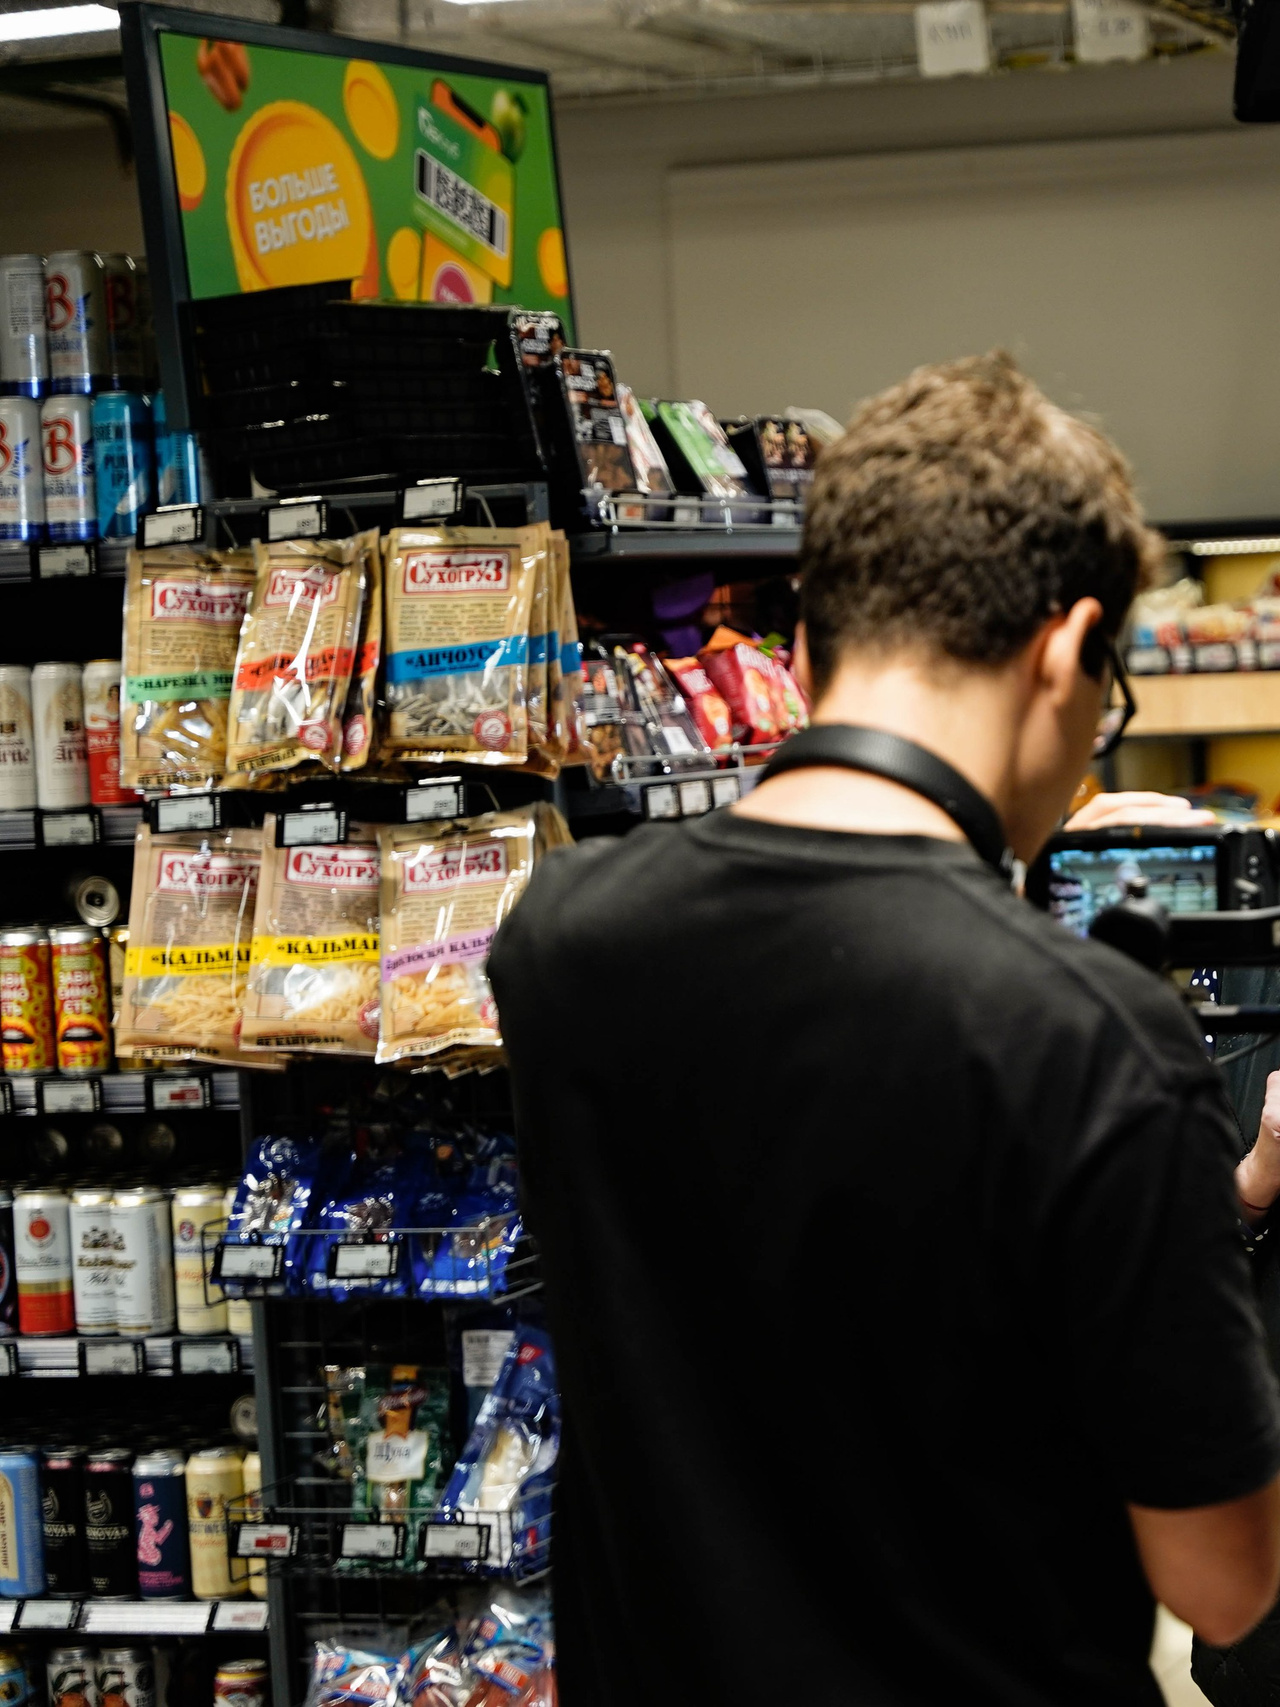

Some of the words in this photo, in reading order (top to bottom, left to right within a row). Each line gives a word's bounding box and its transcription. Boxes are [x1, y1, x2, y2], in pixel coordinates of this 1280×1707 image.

[249, 162, 339, 213] БОЛЬШЕ
[255, 197, 351, 254] ВЫГОДЫ
[293, 852, 380, 879] СУХОГРУ
